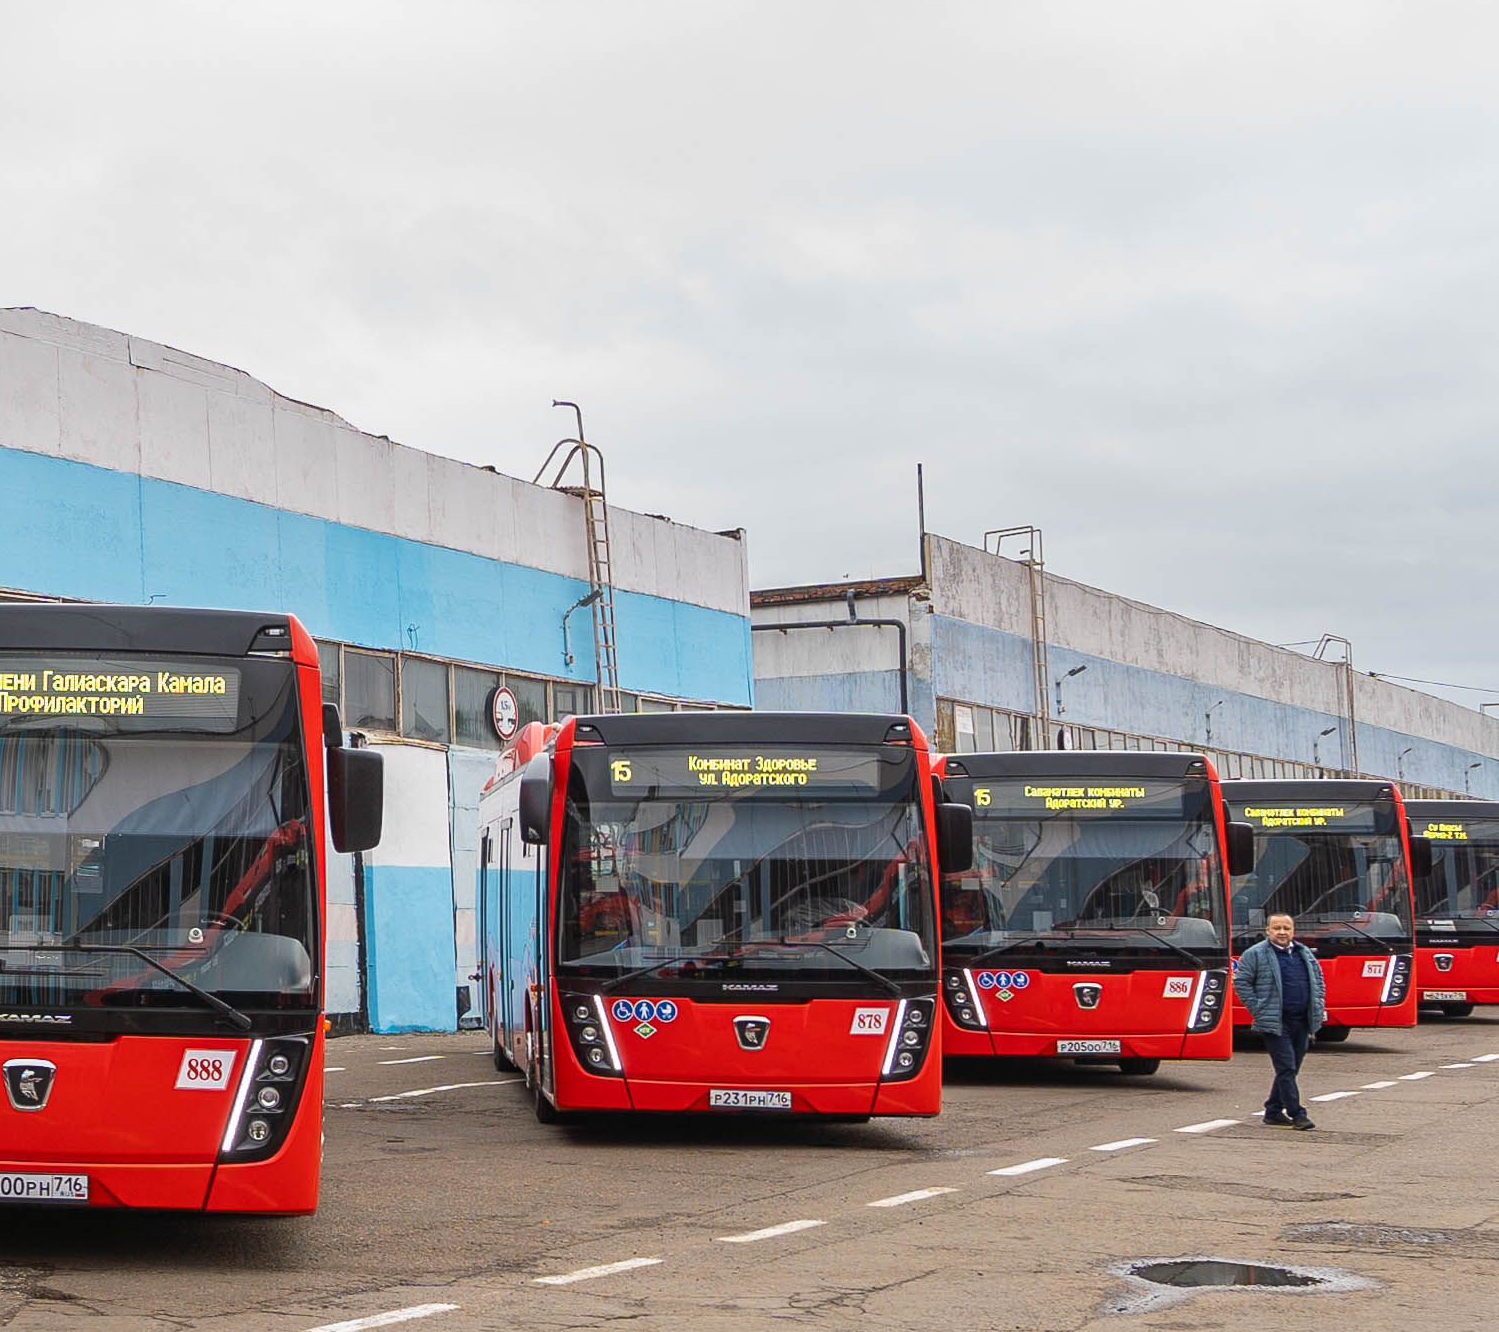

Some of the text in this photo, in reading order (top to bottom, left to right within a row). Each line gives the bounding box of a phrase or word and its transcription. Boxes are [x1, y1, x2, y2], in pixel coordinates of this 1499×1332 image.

[43, 670, 151, 694] Галиаскара
[157, 671, 227, 695] Камала
[610, 759, 633, 782] 15
[688, 755, 817, 773] Комбинат Здоровье
[721, 771, 808, 787] Адоратского
[974, 788, 992, 806] 15
[1168, 981, 1188, 994] 886
[857, 1013, 882, 1029] 878
[186, 1058, 223, 1082] 888
